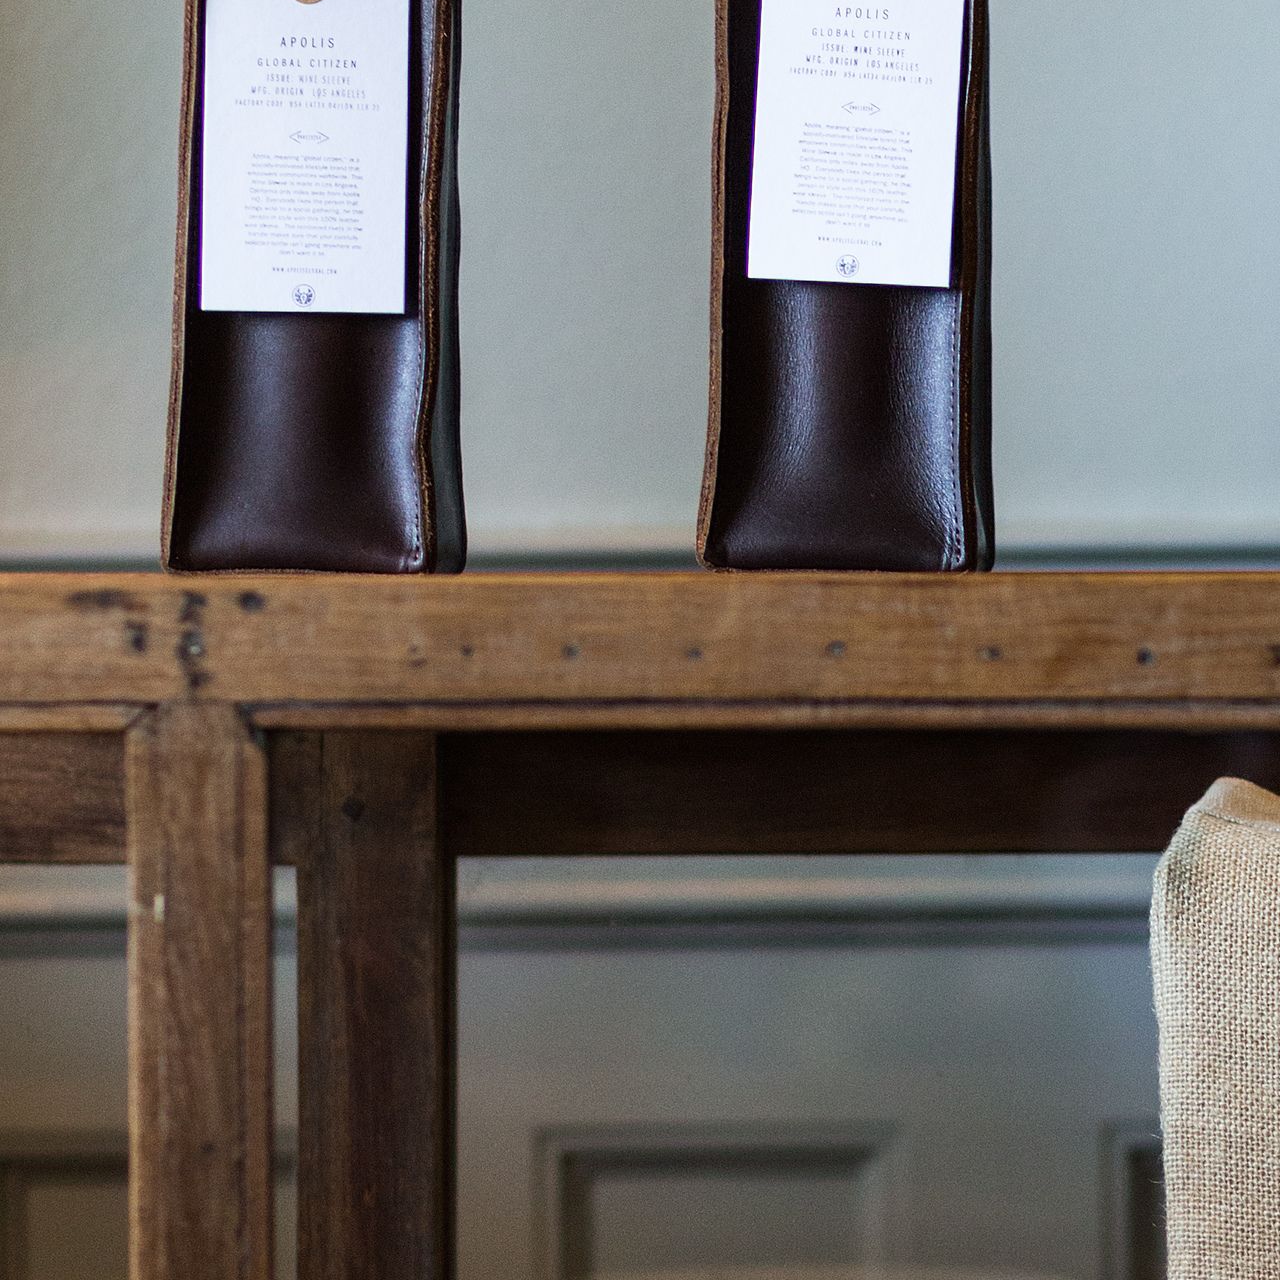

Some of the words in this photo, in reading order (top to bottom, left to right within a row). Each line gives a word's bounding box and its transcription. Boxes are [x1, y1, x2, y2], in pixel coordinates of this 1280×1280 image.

[835, 7, 889, 20] APOLIS
[811, 27, 856, 38] GLOBAL
[863, 30, 911, 41] CITIZEN
[280, 36, 336, 49] APOLIS
[257, 57, 302, 68] GLOBAL
[309, 58, 358, 69] CITIZEN
